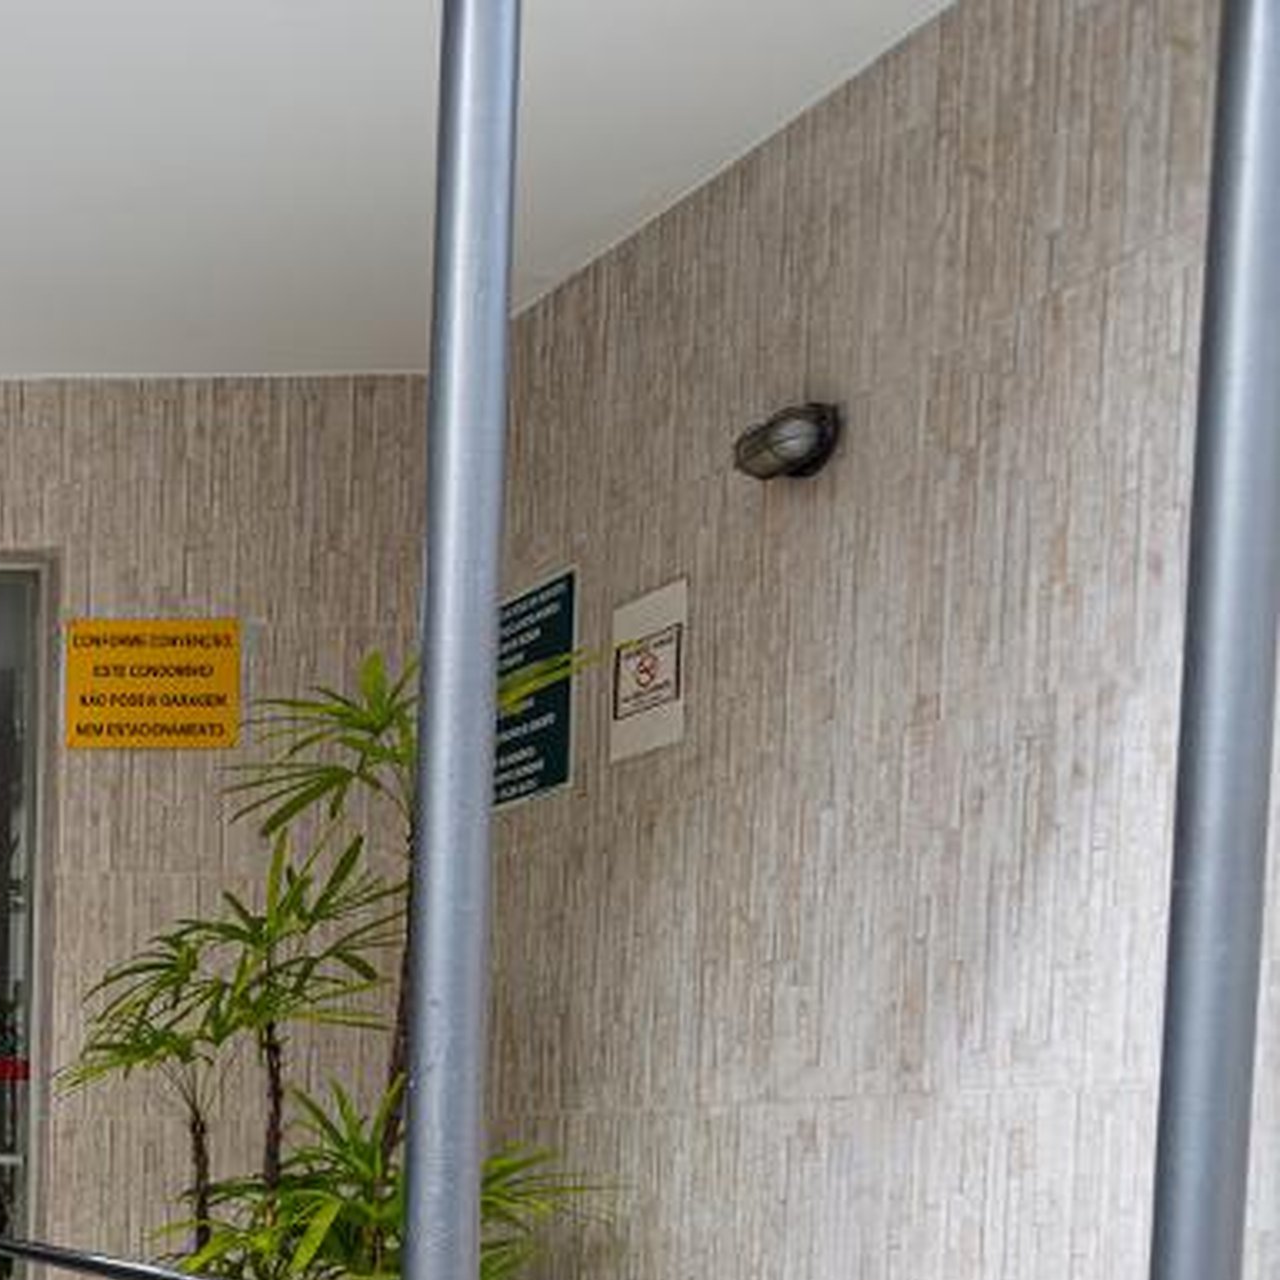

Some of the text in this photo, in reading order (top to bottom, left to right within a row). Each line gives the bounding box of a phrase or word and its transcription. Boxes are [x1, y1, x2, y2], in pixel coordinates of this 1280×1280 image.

[73, 634, 147, 649] CONFORME
[93, 664, 127, 678] ESTE
[159, 693, 228, 707] GARAGEM
[76, 723, 104, 737] NEM
